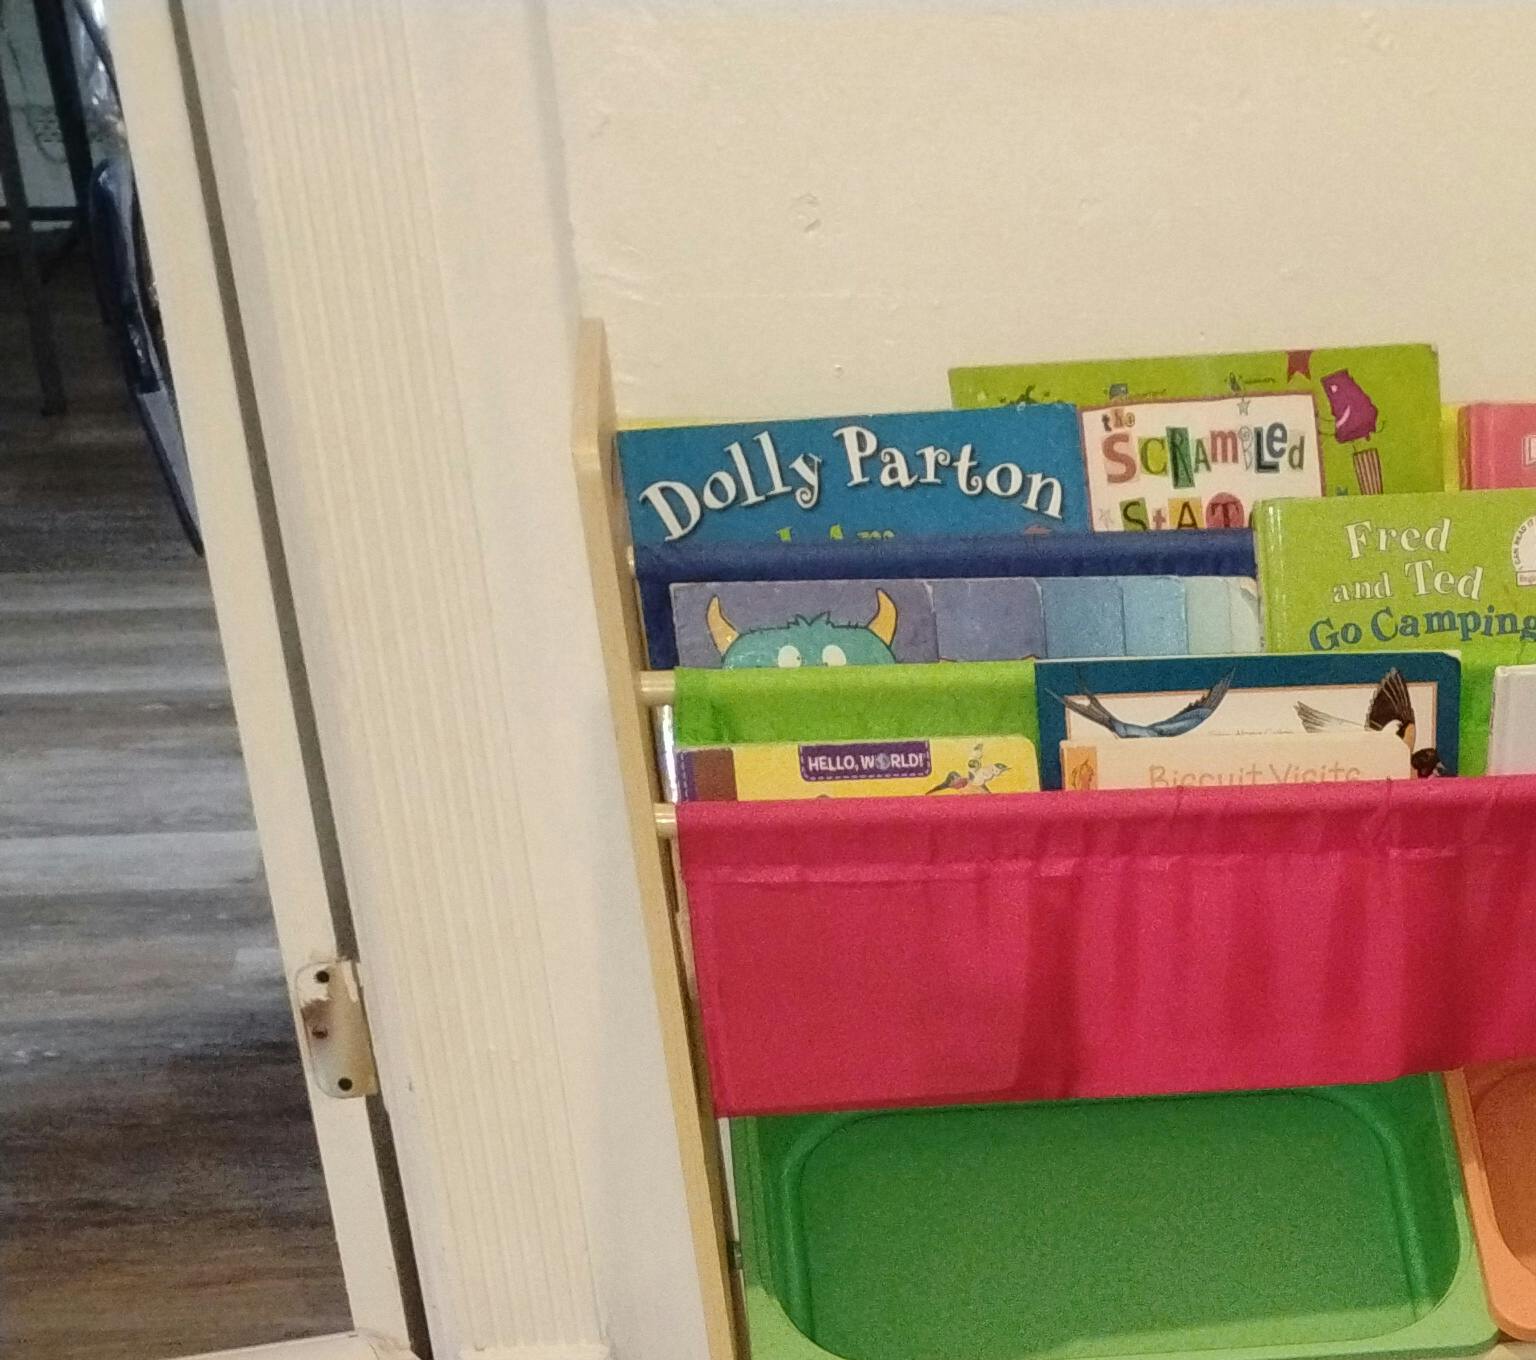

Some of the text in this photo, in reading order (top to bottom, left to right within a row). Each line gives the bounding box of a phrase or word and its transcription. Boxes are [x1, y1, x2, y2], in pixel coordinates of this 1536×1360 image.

[639, 425, 1063, 541] Dolly Parton
[1344, 518, 1452, 561] Fred
[1332, 560, 1483, 603] and Ted
[1309, 609, 1362, 651] Go
